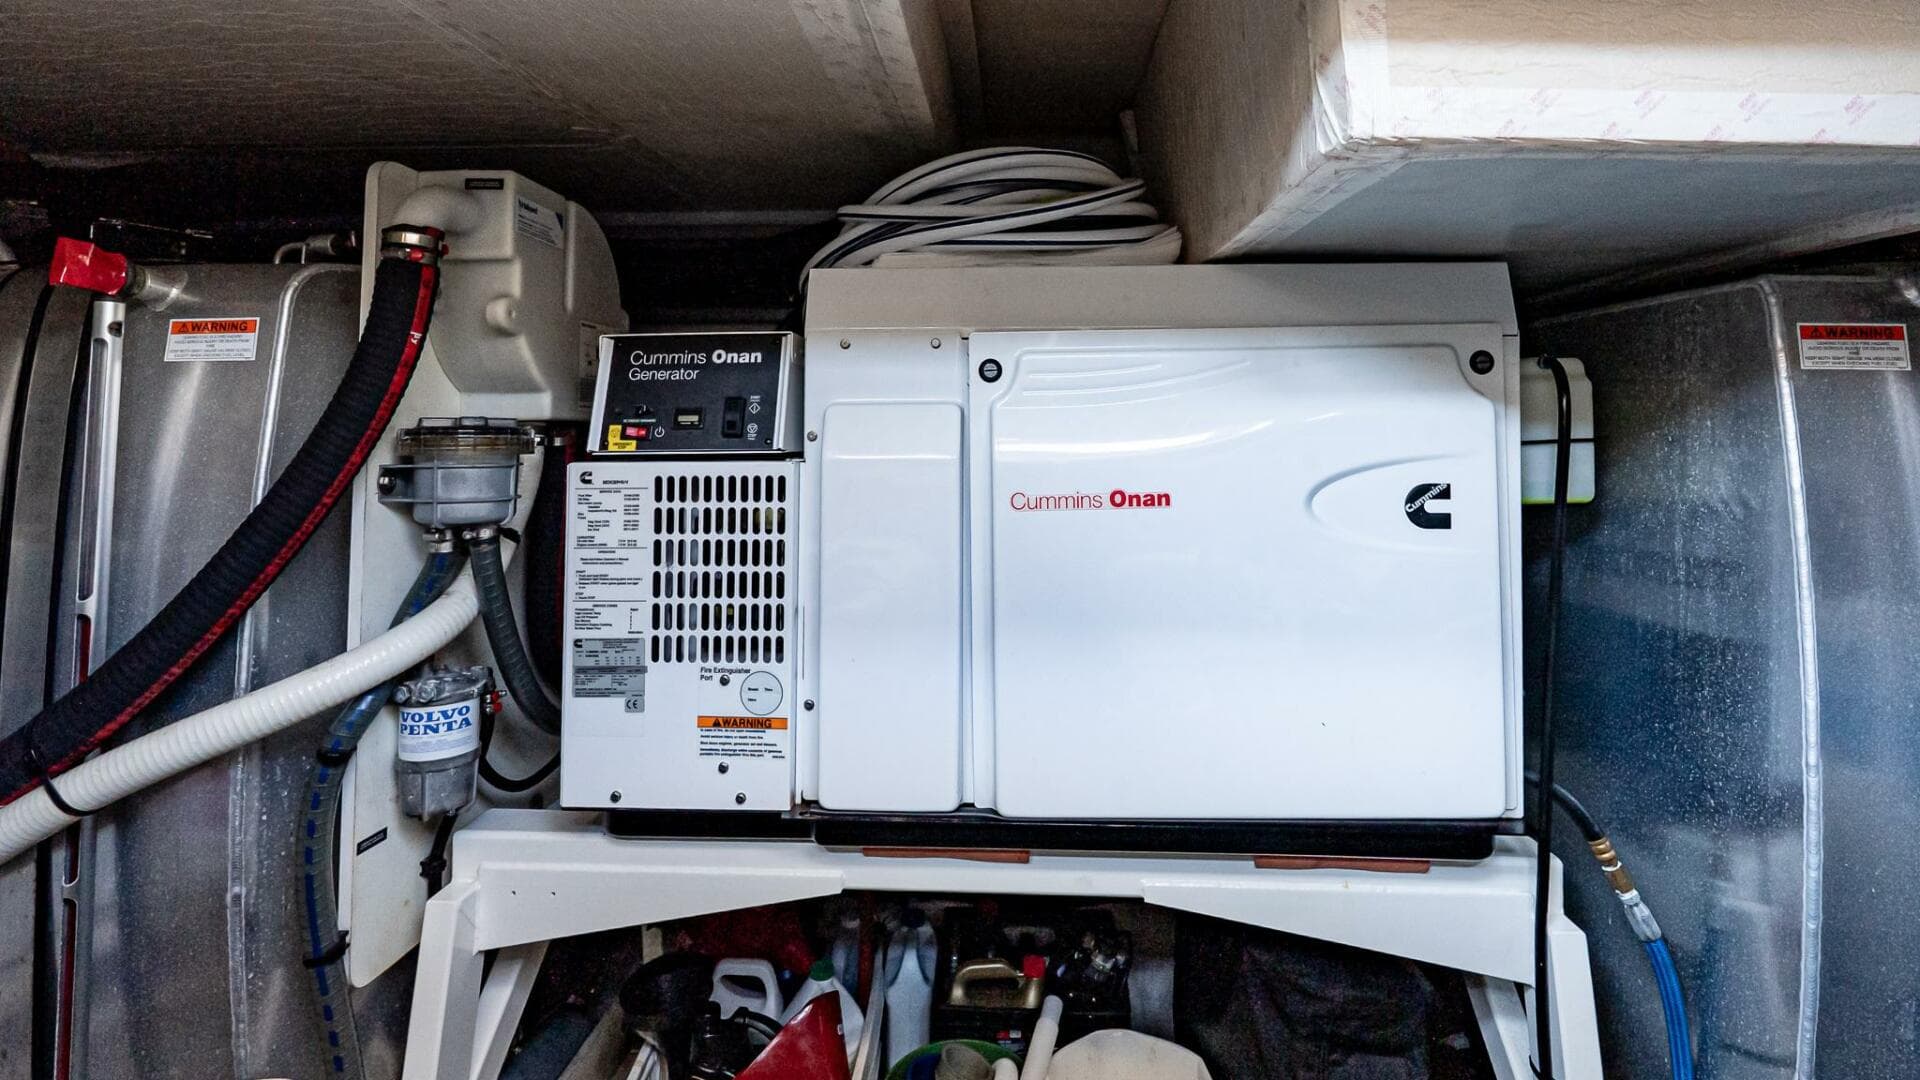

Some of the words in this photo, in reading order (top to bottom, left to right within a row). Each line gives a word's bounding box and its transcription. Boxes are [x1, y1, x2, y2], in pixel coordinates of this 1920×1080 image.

[191, 321, 248, 332] WARNING
[1826, 327, 1894, 338] WARNING
[630, 350, 707, 366] Cummins
[712, 349, 762, 364] Onan
[628, 367, 700, 380] Generator
[1010, 491, 1103, 510] Cummins
[1109, 490, 1171, 508] Onan
[1405, 483, 1448, 513] Cummins
[713, 667, 751, 676] Extinguisher
[400, 705, 470, 723] VOLVO
[400, 717, 472, 735] PENTA
[722, 718, 773, 729] WARNING
